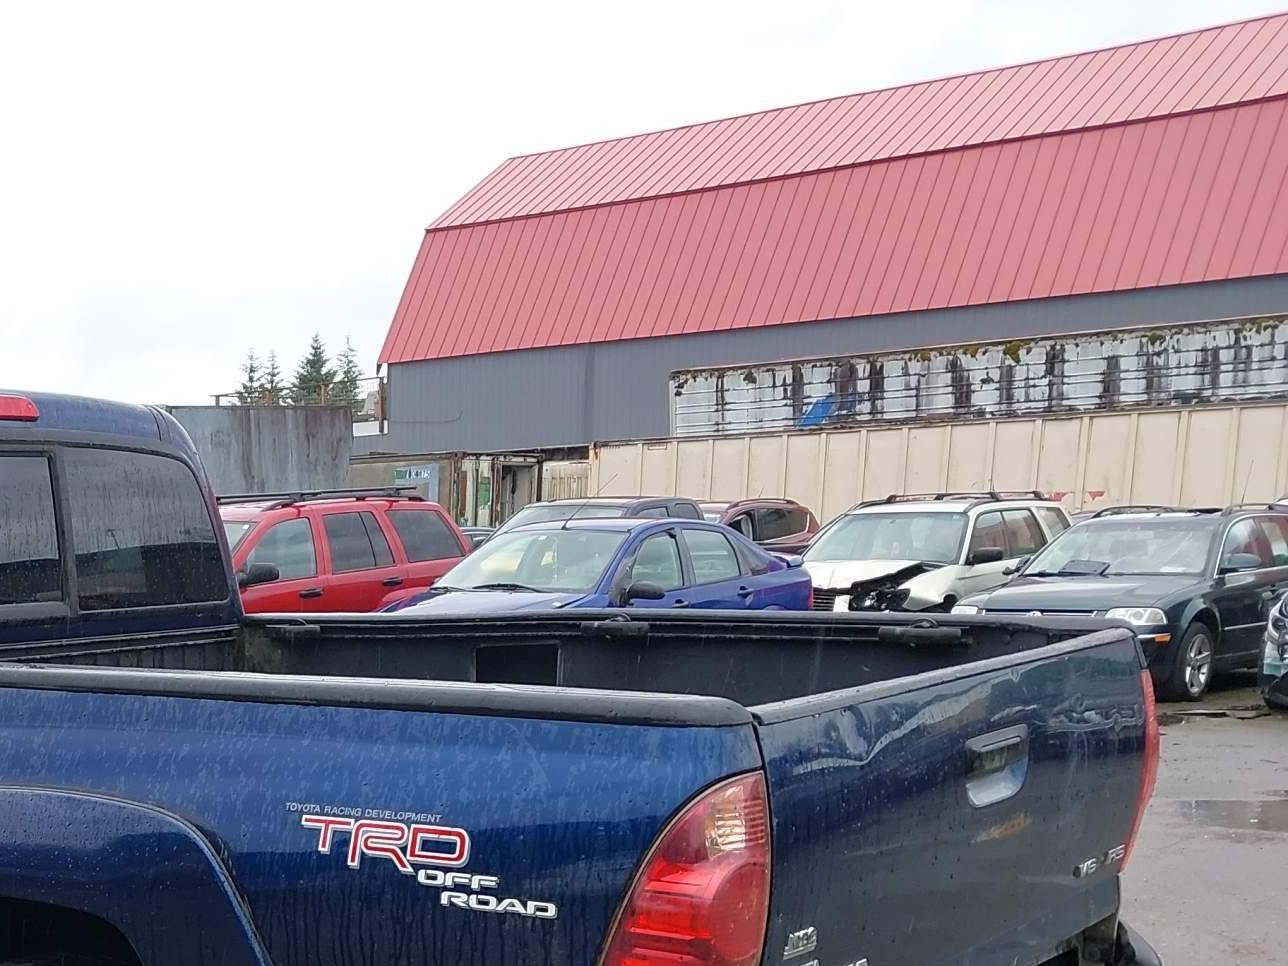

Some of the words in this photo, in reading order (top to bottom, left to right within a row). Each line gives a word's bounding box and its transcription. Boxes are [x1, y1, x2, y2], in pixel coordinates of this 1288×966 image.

[285, 801, 321, 813] TOYOTA
[324, 805, 362, 817] RACING
[365, 808, 442, 823] DEVELOPMENT
[301, 813, 471, 875] TRD
[417, 868, 499, 890] OFF
[440, 890, 558, 919] ROAD
